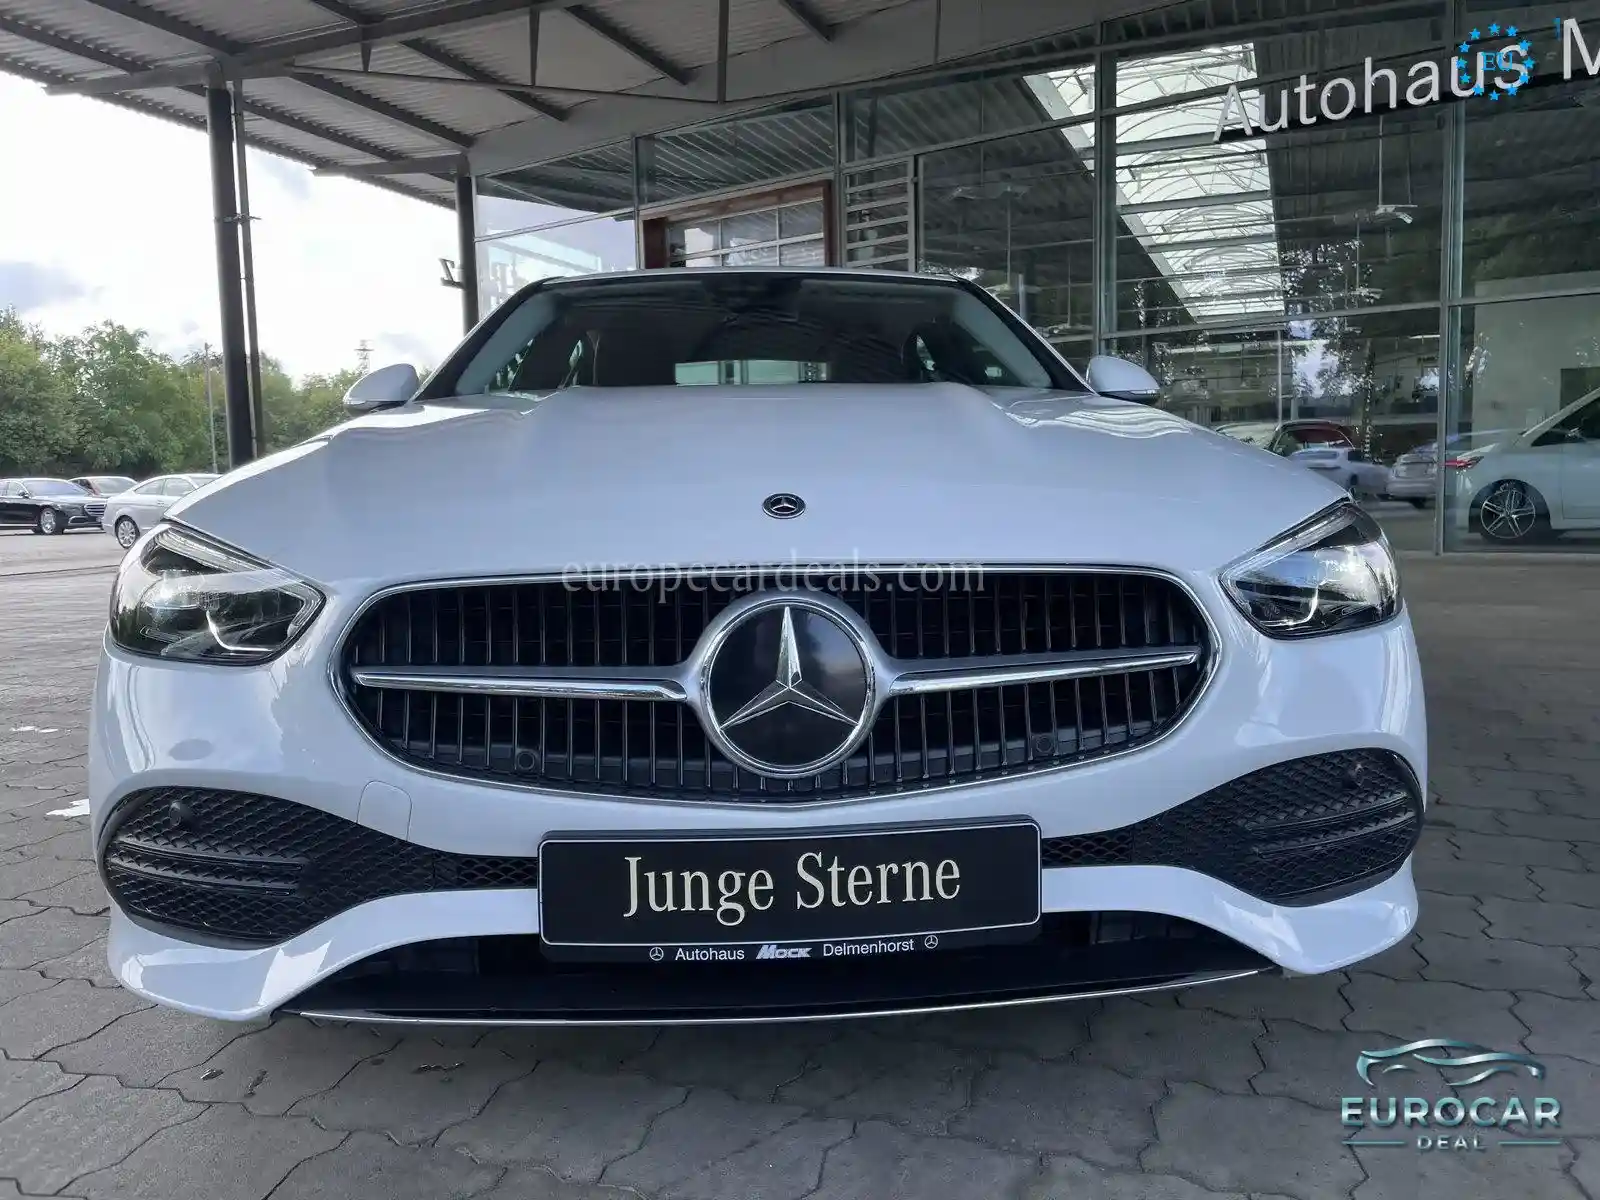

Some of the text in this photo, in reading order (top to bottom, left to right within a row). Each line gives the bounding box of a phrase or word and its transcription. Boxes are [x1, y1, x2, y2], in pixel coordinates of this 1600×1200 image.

[1213, 43, 1529, 142] Autohaus
[623, 850, 962, 926] Junge Sterne
[674, 947, 746, 962] Autohaus
[822, 938, 915, 957] Delmenhorst
